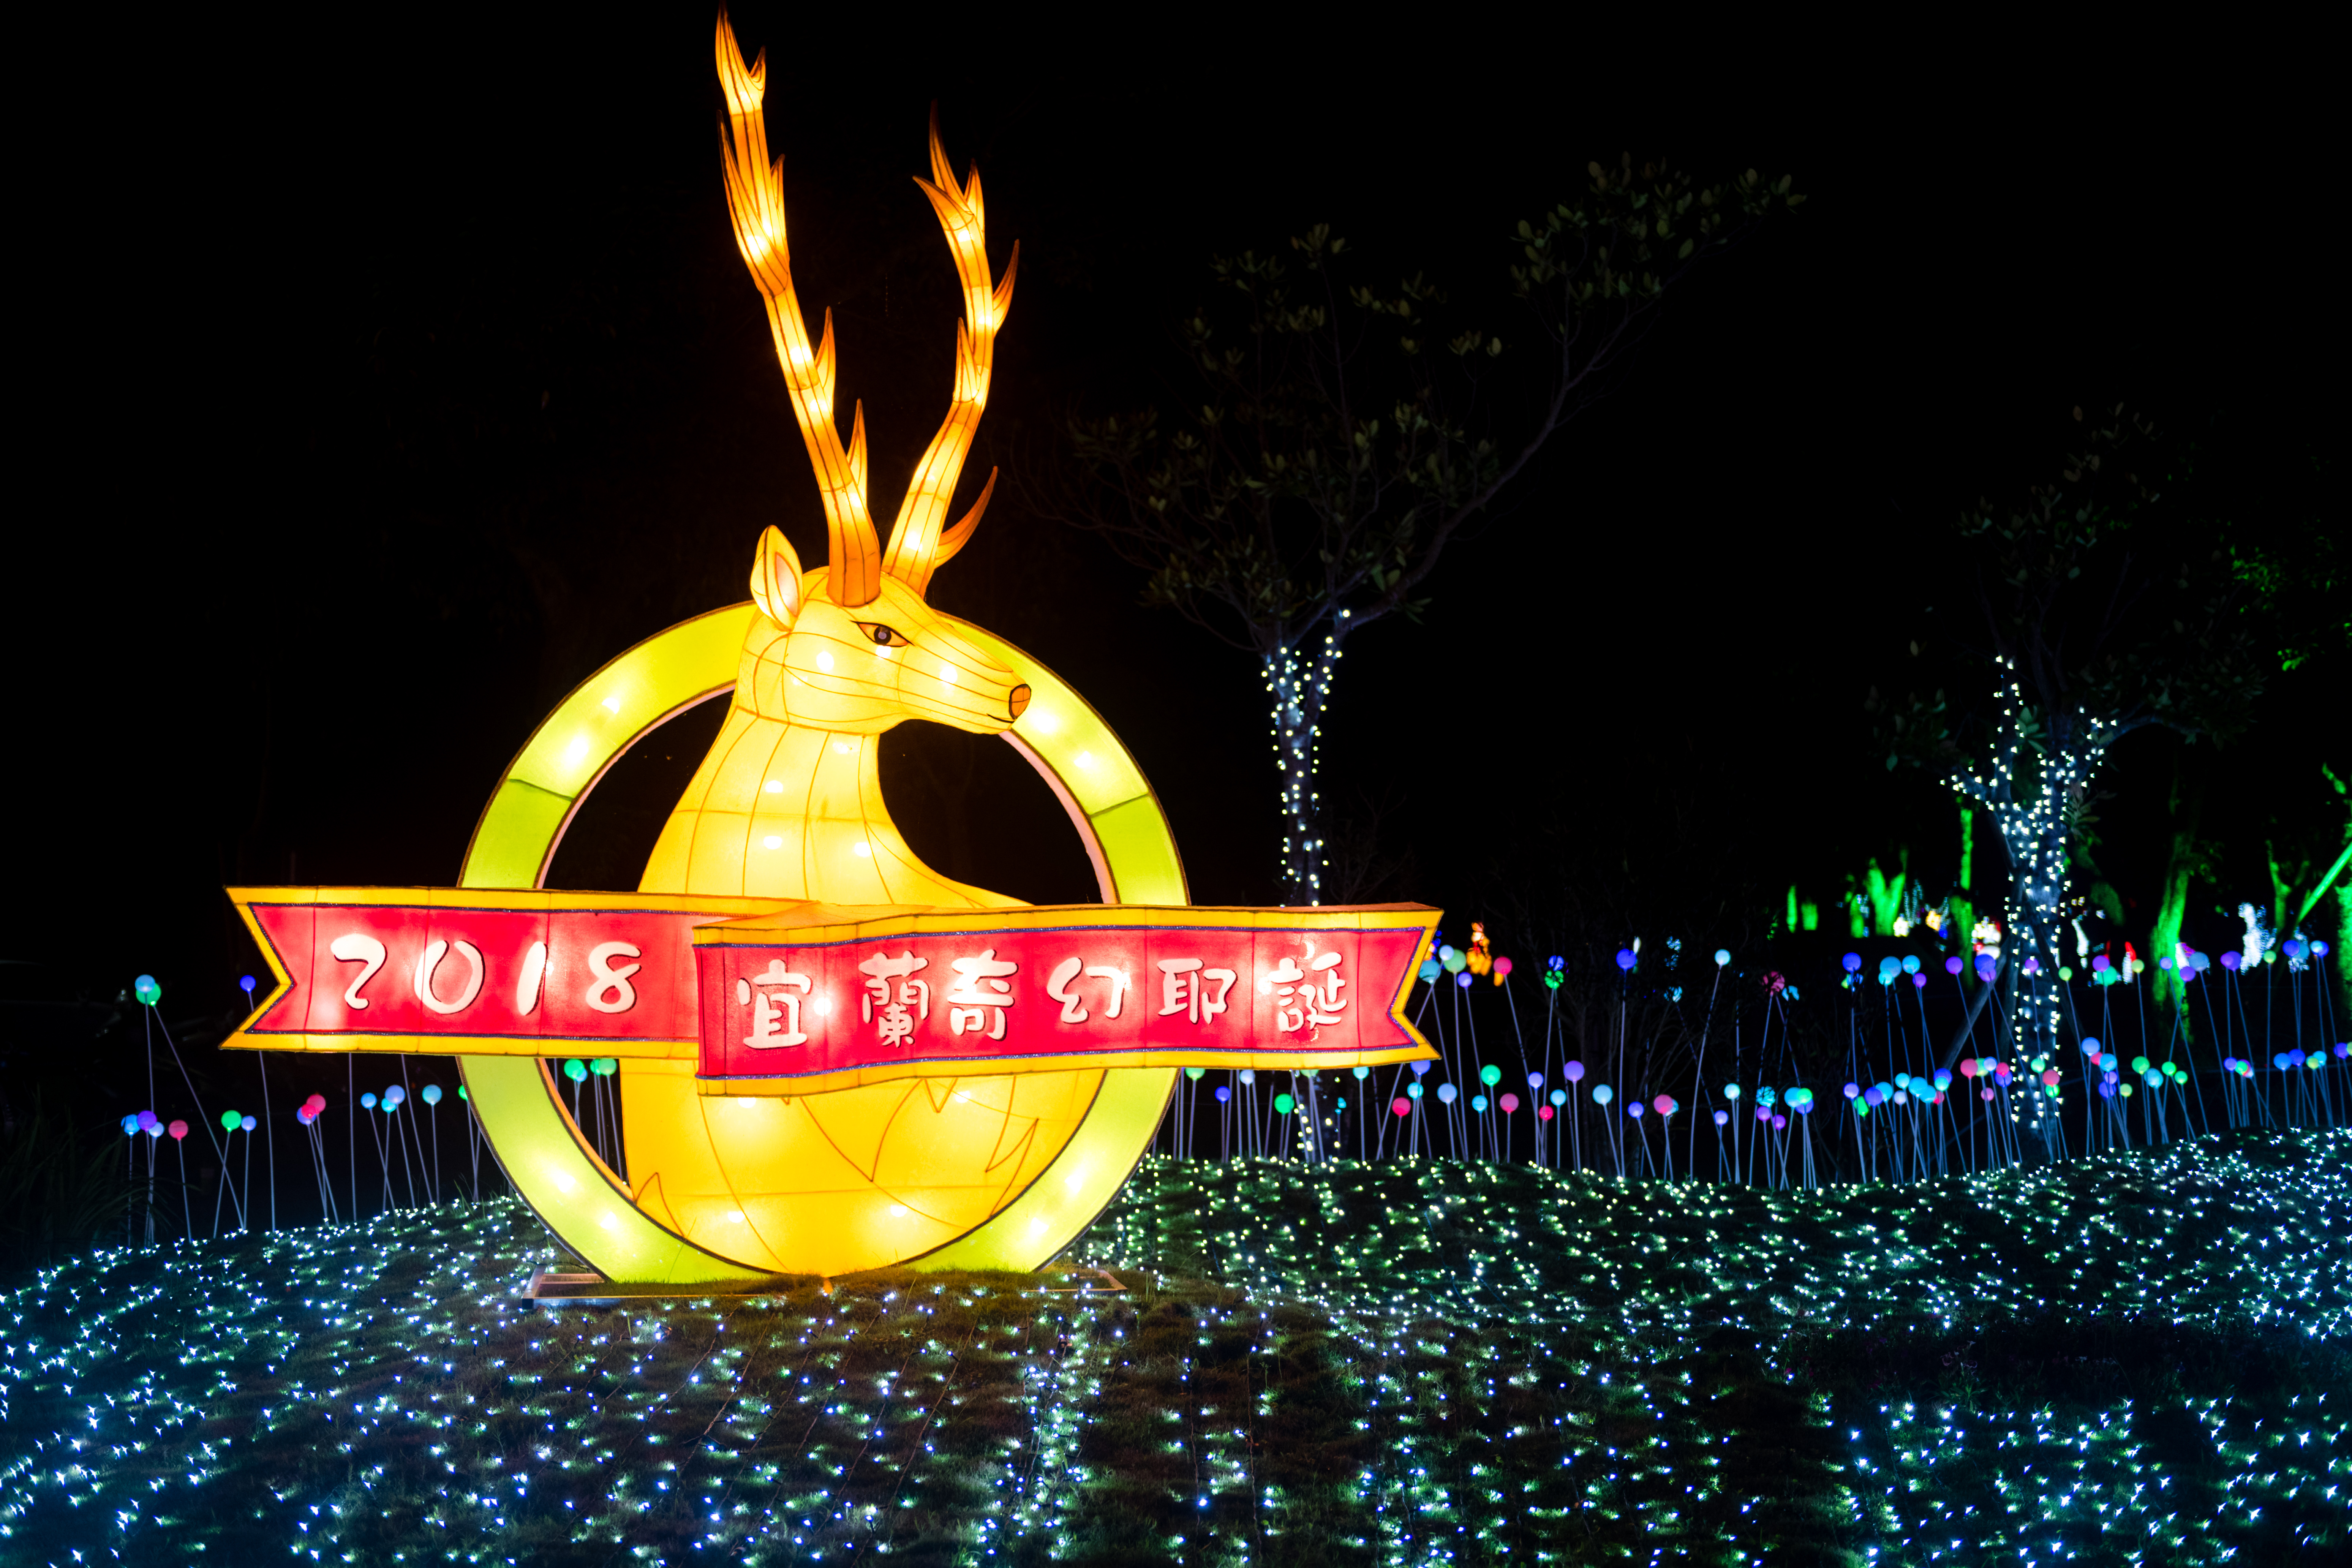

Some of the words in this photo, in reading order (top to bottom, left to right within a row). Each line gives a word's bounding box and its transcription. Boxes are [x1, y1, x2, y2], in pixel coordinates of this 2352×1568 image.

[331, 934, 642, 1016] 2018
[737, 949, 1348, 1050] 宜蘭奇幻耶誕
